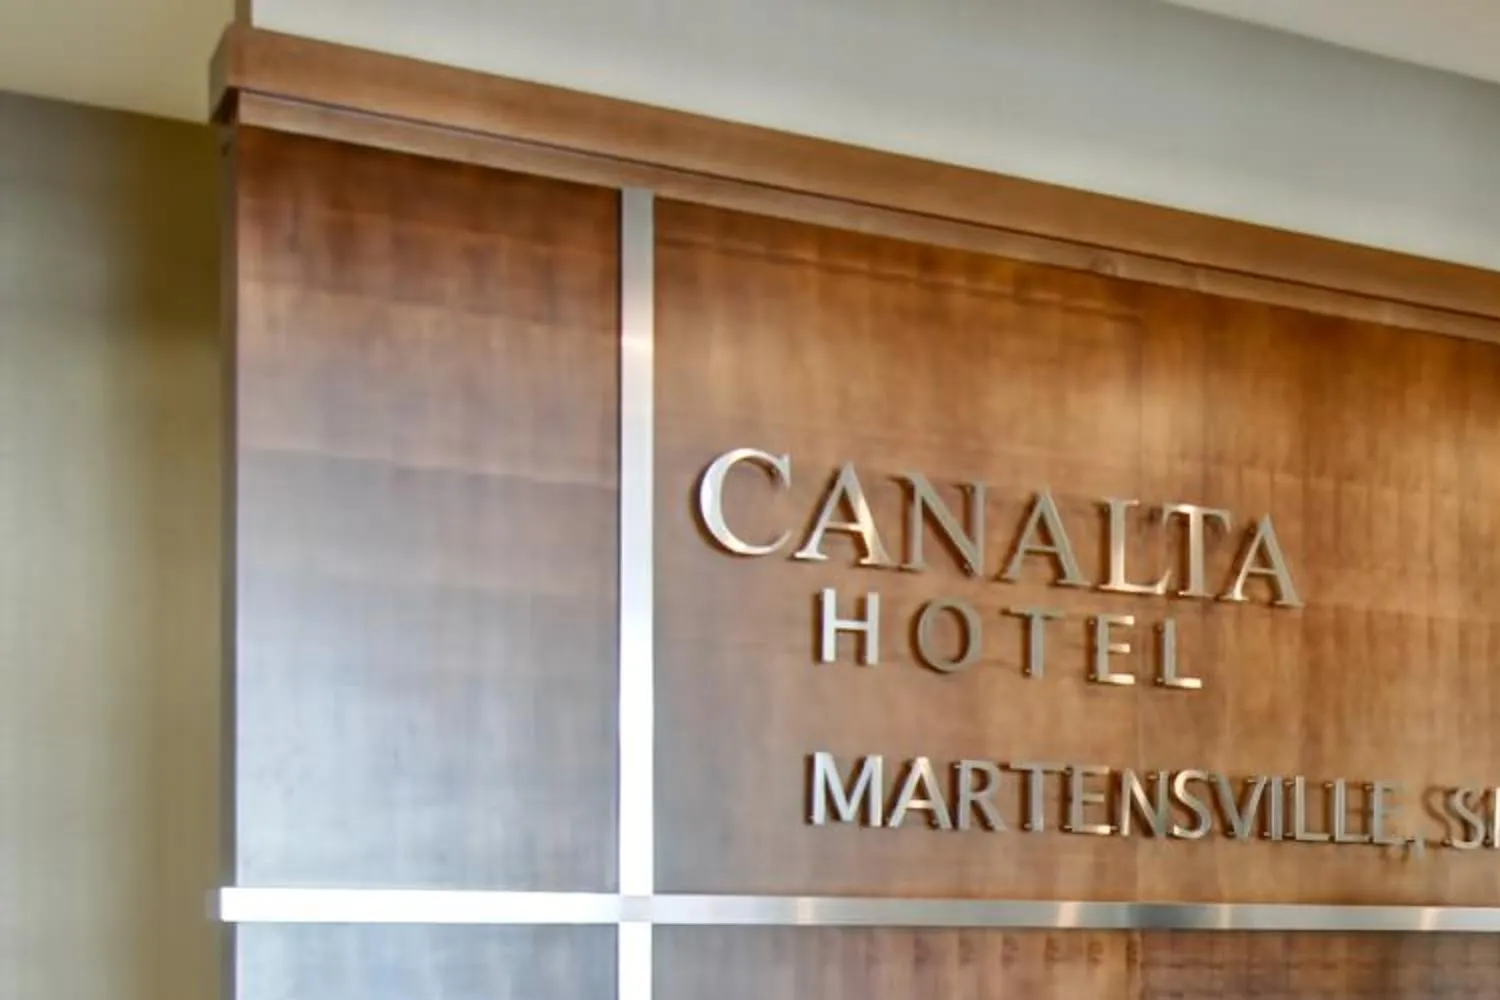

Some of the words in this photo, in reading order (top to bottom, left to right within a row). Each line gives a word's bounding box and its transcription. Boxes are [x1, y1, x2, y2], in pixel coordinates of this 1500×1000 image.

[699, 448, 1304, 608] CANALTA
[820, 587, 1203, 689] HOTEL
[810, 751, 1428, 861] MARTENSVILLE,
